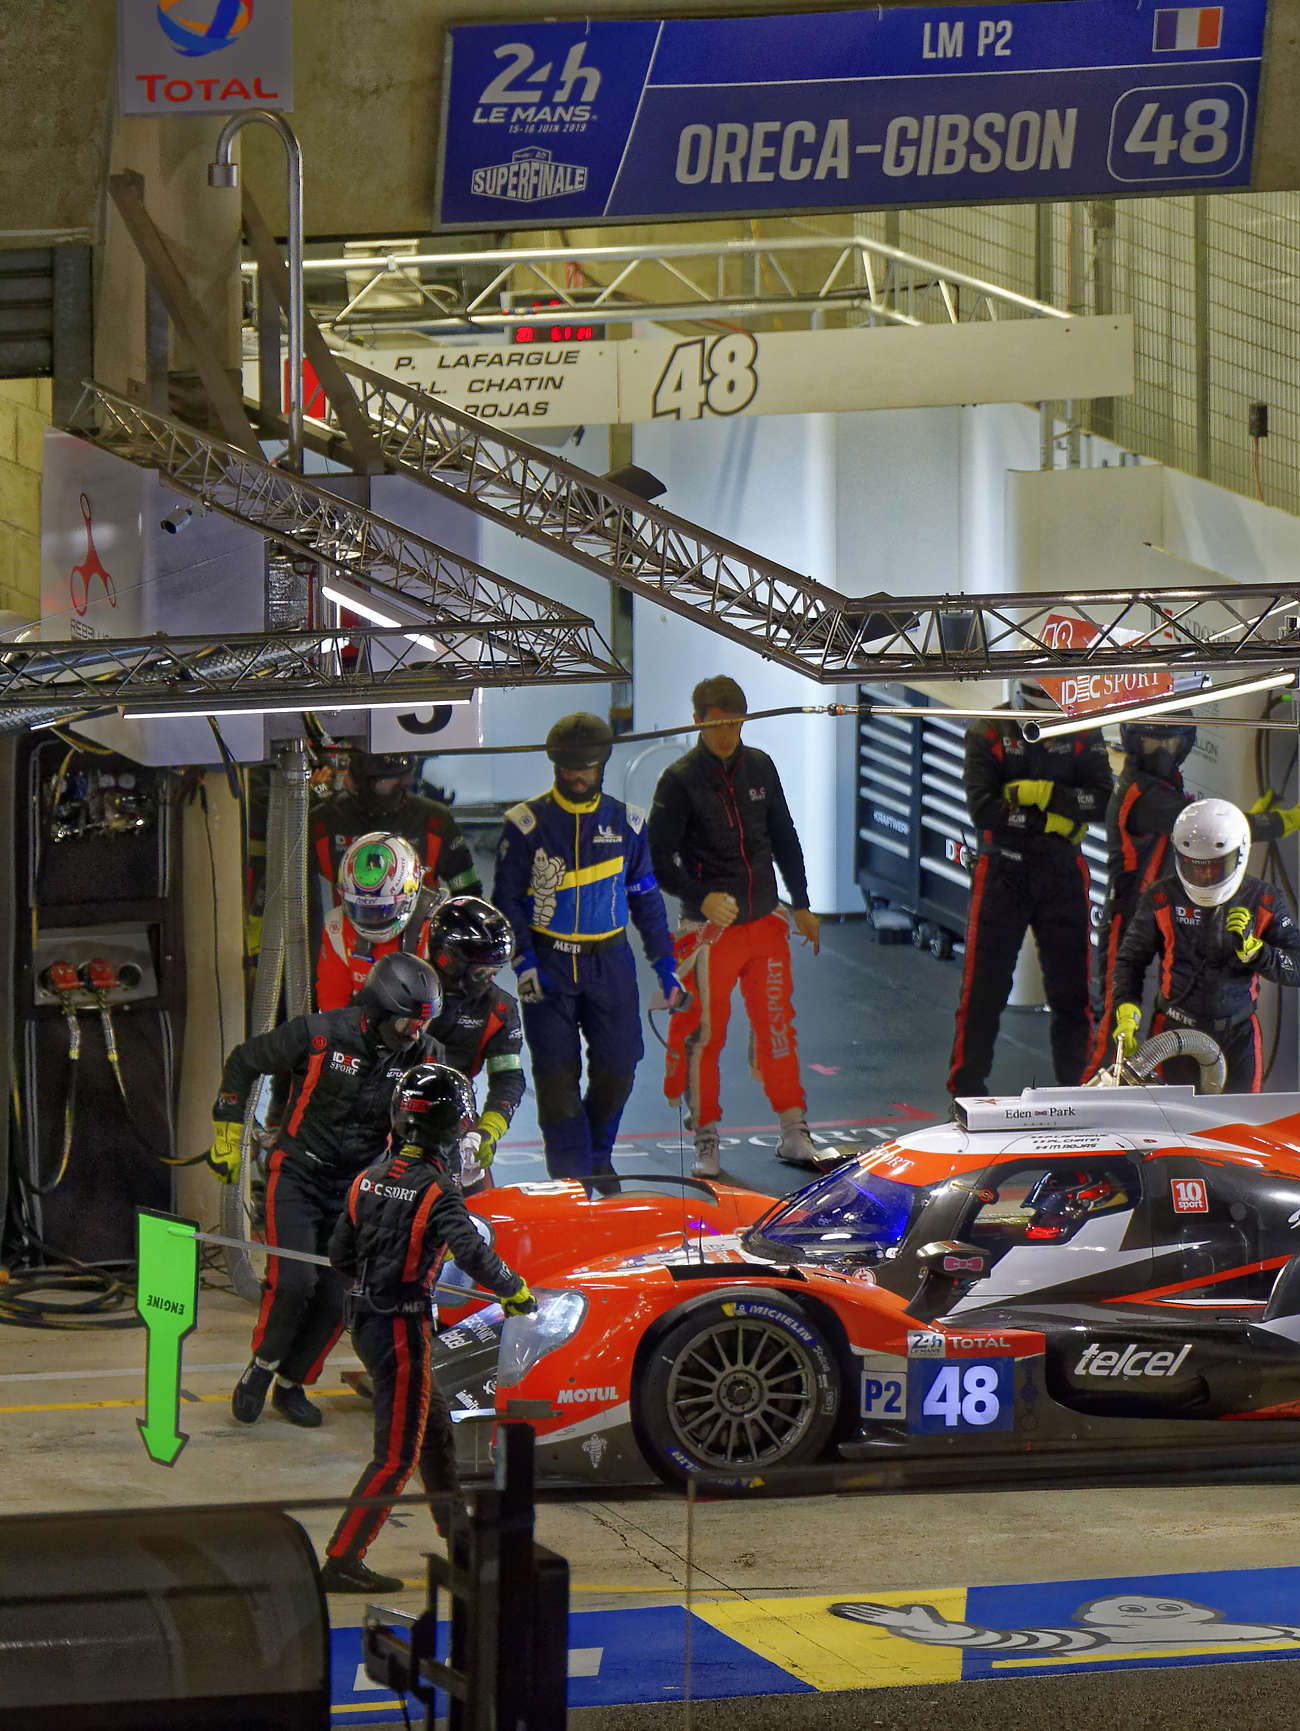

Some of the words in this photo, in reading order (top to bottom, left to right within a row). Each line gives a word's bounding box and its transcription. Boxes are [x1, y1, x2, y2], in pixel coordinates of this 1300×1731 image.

[922, 23, 963, 59] LM
[977, 20, 1012, 57] P2
[479, 41, 602, 104] 24h
[135, 74, 279, 103] TOTAL
[472, 107, 508, 123] LE
[511, 105, 592, 123] MANS
[1123, 98, 1229, 166] 48
[675, 108, 1078, 186] ORECA-GIBSON
[474, 162, 586, 201] SUPERFINALE
[394, 354, 416, 372] P.
[437, 350, 580, 370] LAFARGUE
[467, 376, 564, 393] CHATIN
[652, 333, 758, 419] 48
[1061, 674, 1101, 705] IDEC
[1103, 672, 1159, 696] SPORT
[766, 957, 784, 1023] SPORT
[329, 1061, 359, 1077] SPORT
[332, 1051, 361, 1068] IDEC
[1004, 1108, 1032, 1120] Eden
[1049, 1106, 1076, 1118] Park
[1174, 1181, 1203, 1202] 10
[1177, 1199, 1204, 1211] sport
[146, 1294, 185, 1316] ENGINE
[749, 1305, 812, 1341] MICHELIN
[912, 1333, 943, 1349] 24h
[948, 1335, 1011, 1349] TOTAL
[1073, 1343, 1193, 1377] telcel
[557, 1386, 619, 1404] MOTUL
[864, 1378, 902, 1414] P2
[923, 1365, 1000, 1427] 48
